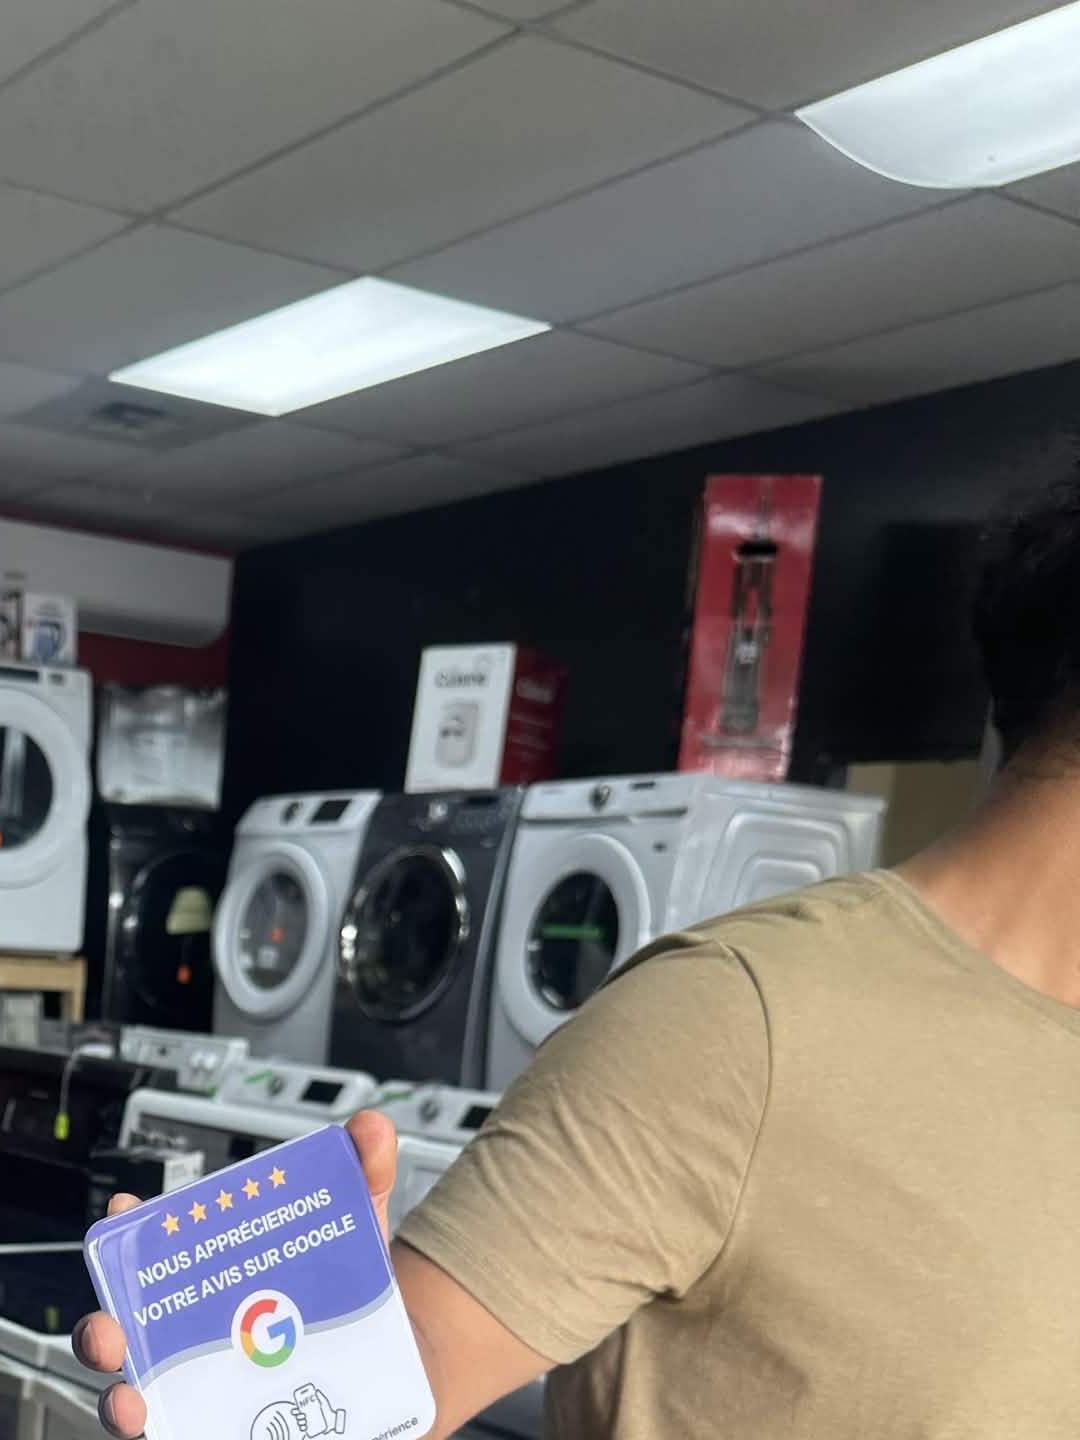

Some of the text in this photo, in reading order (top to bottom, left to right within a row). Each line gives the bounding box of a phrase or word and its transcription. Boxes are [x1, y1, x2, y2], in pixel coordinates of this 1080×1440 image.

[133, 1212, 356, 1327] VOTRE AVIS SUR GOOGLE
[137, 1188, 332, 1288] NOUS APPRÉCIERIONS
[240, 1299, 297, 1368] G
[299, 1394, 316, 1408] NFC
